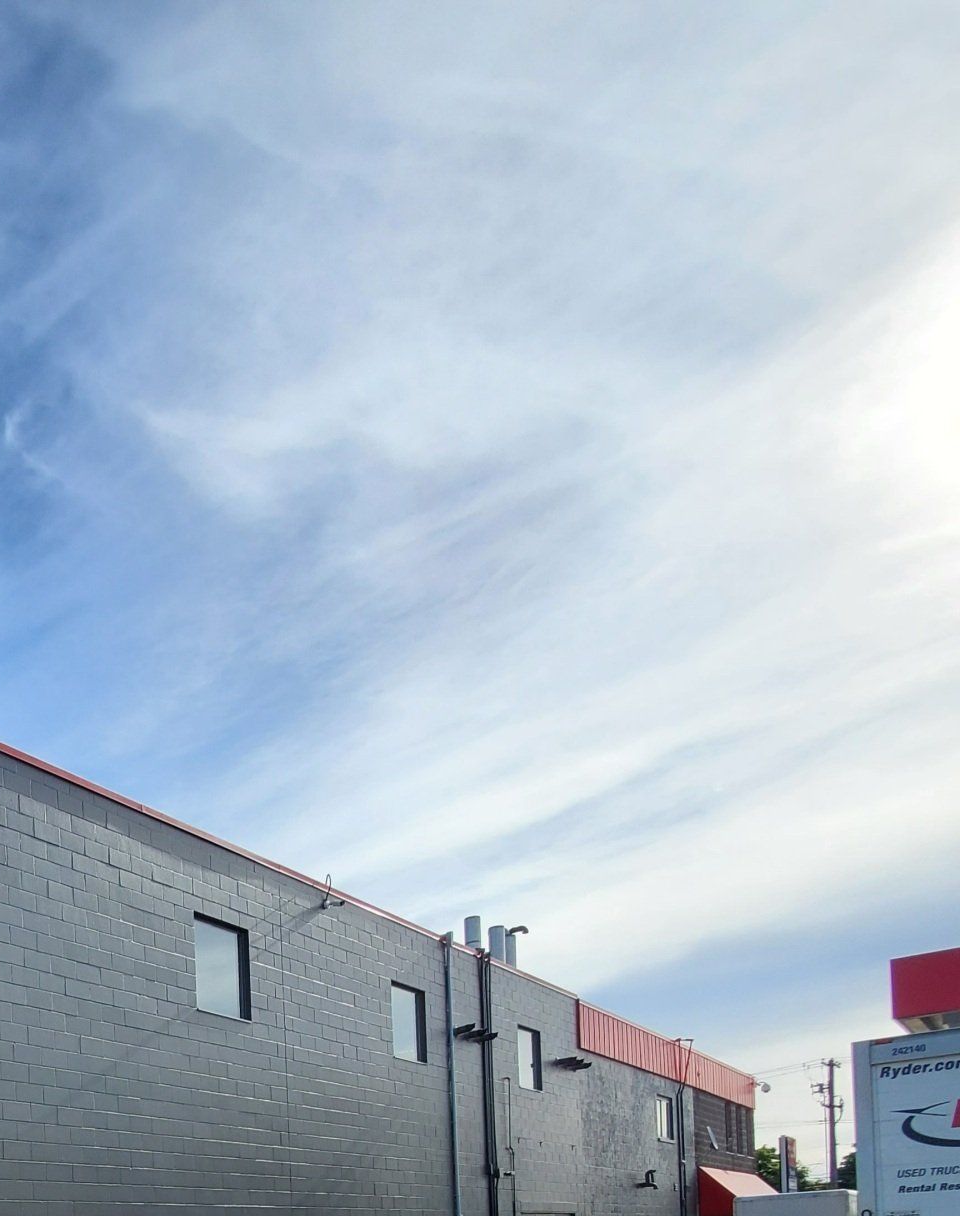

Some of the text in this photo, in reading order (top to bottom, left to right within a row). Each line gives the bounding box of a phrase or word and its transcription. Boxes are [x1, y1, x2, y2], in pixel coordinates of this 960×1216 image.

[892, 1044, 927, 1056] 242140
[897, 1165, 960, 1179] USED TRUC
[898, 1183, 937, 1193] Rental
